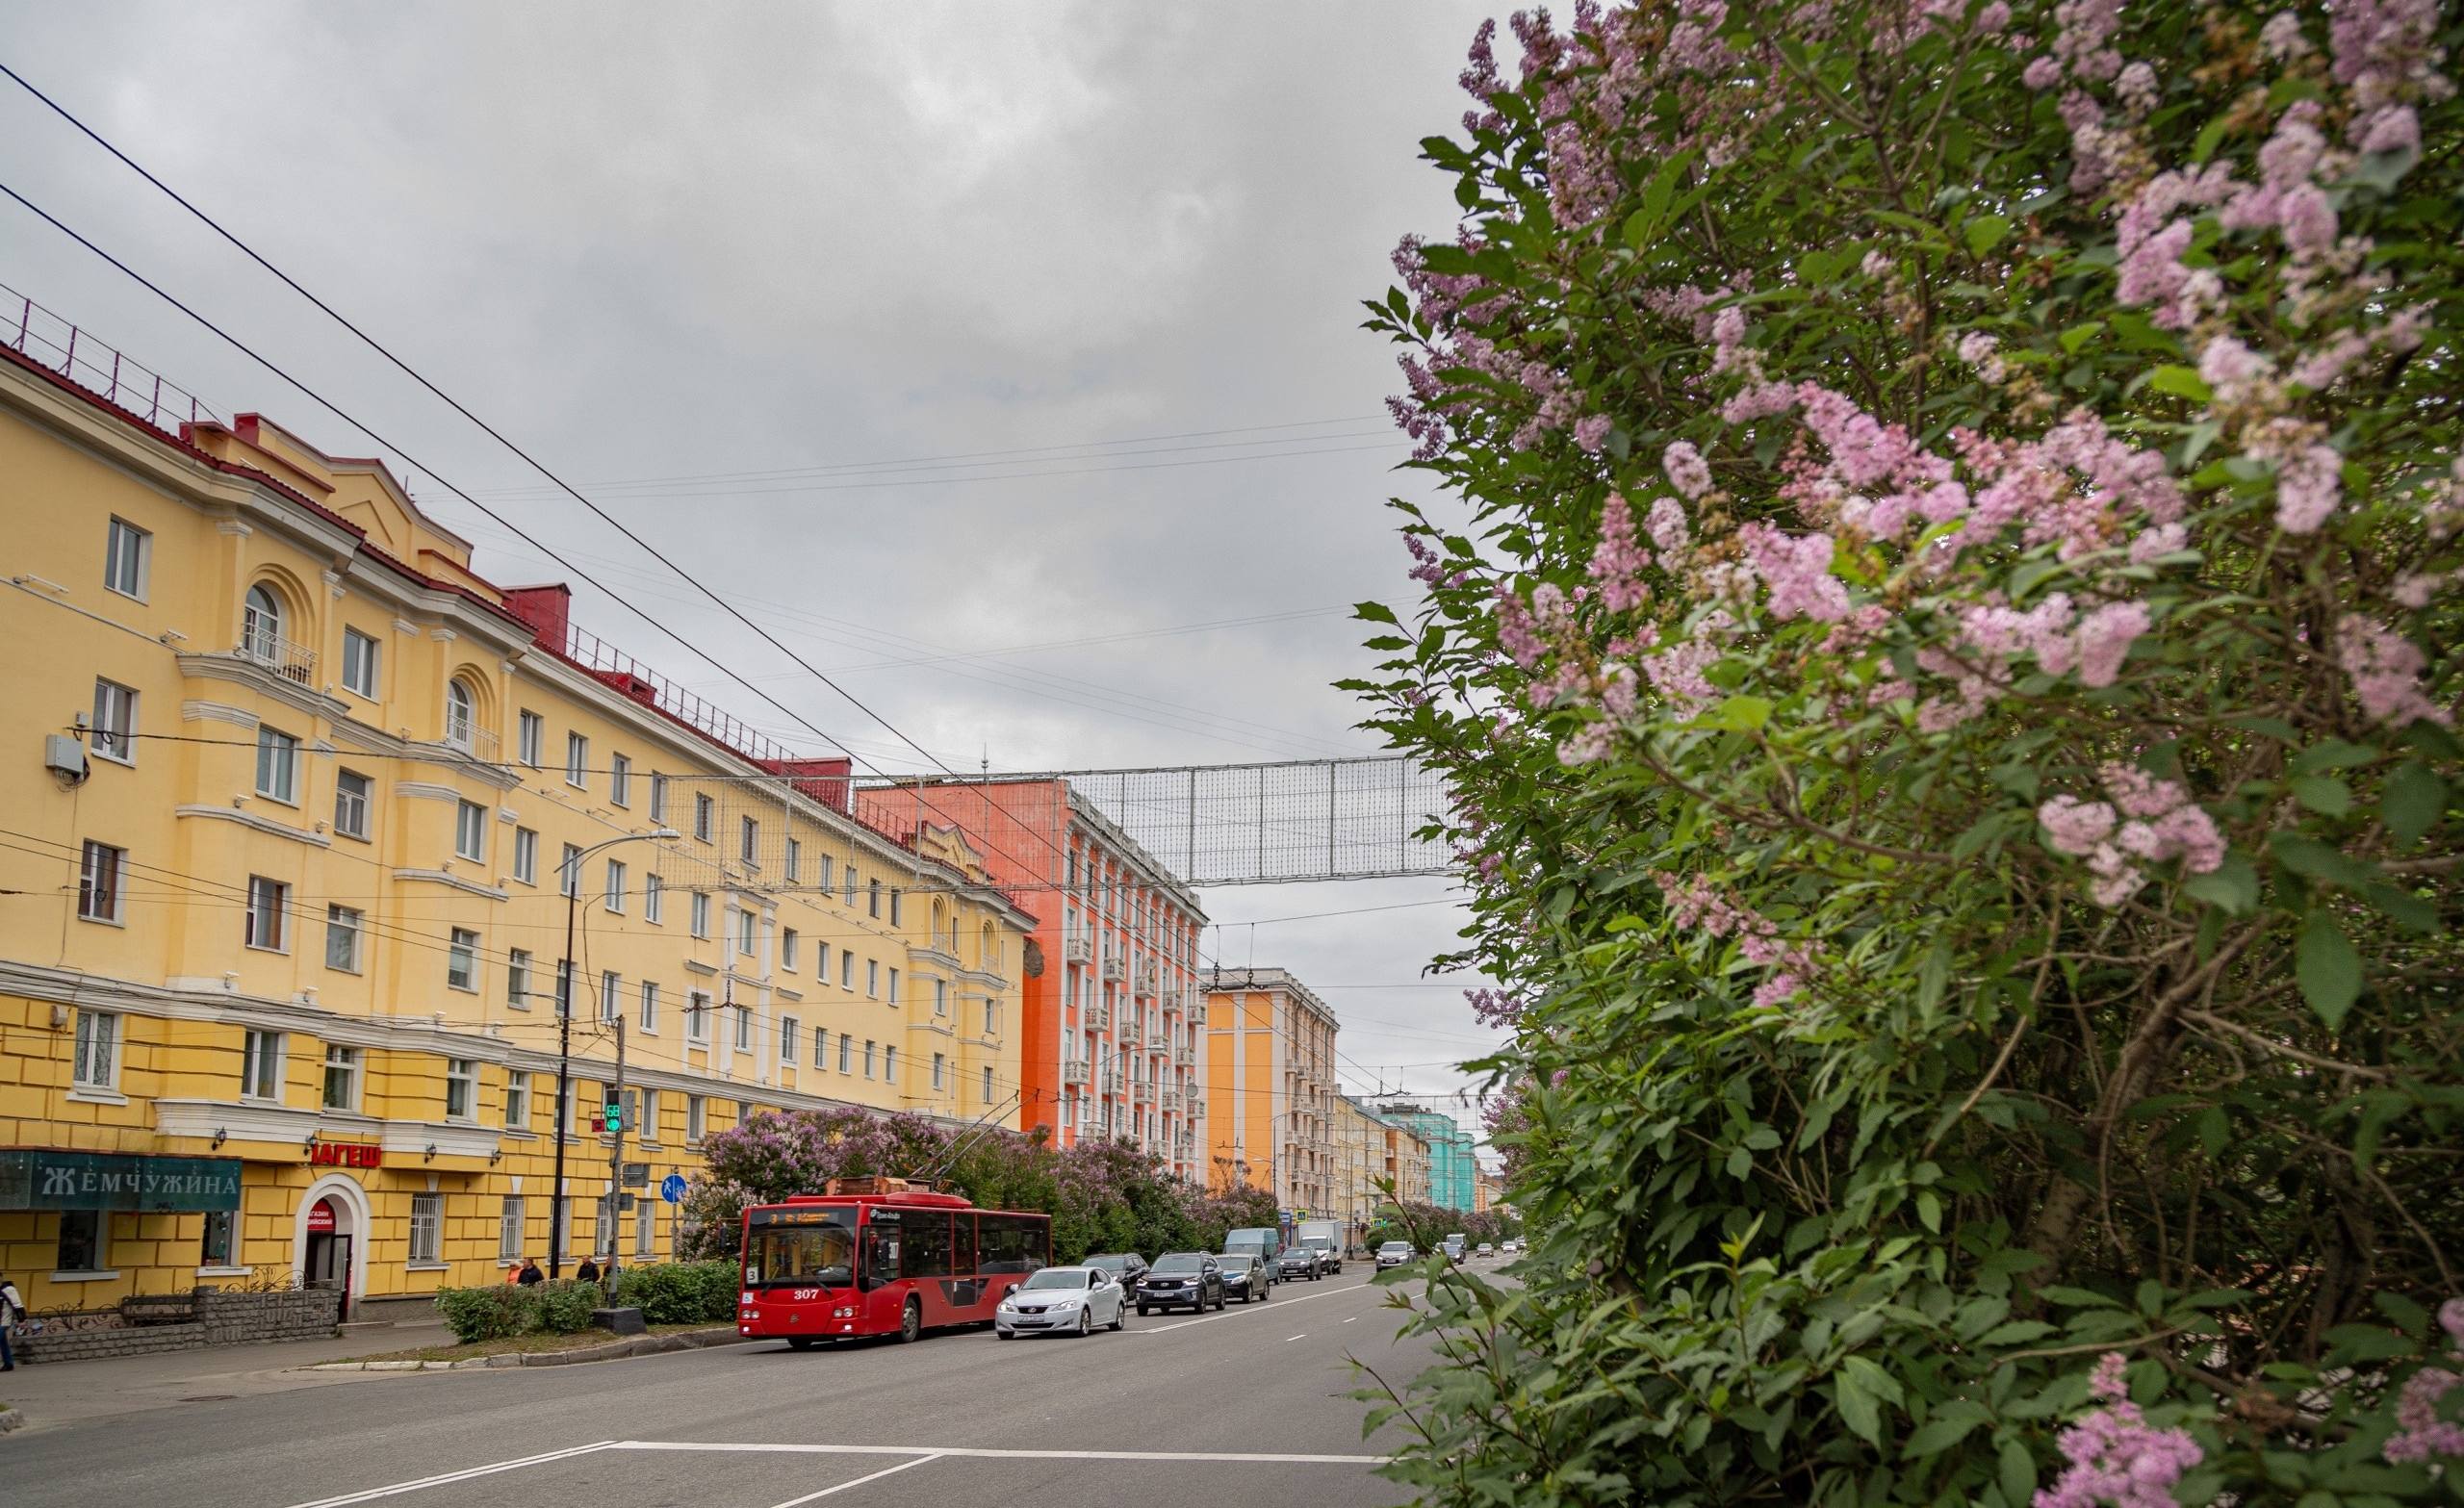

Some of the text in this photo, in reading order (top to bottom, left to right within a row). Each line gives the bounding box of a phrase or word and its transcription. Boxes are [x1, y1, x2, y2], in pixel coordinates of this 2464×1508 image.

[41, 1166, 238, 1195] ЖЕМЧУЖИНА
[749, 1270, 756, 1281] 3
[794, 1289, 819, 1300] 307
